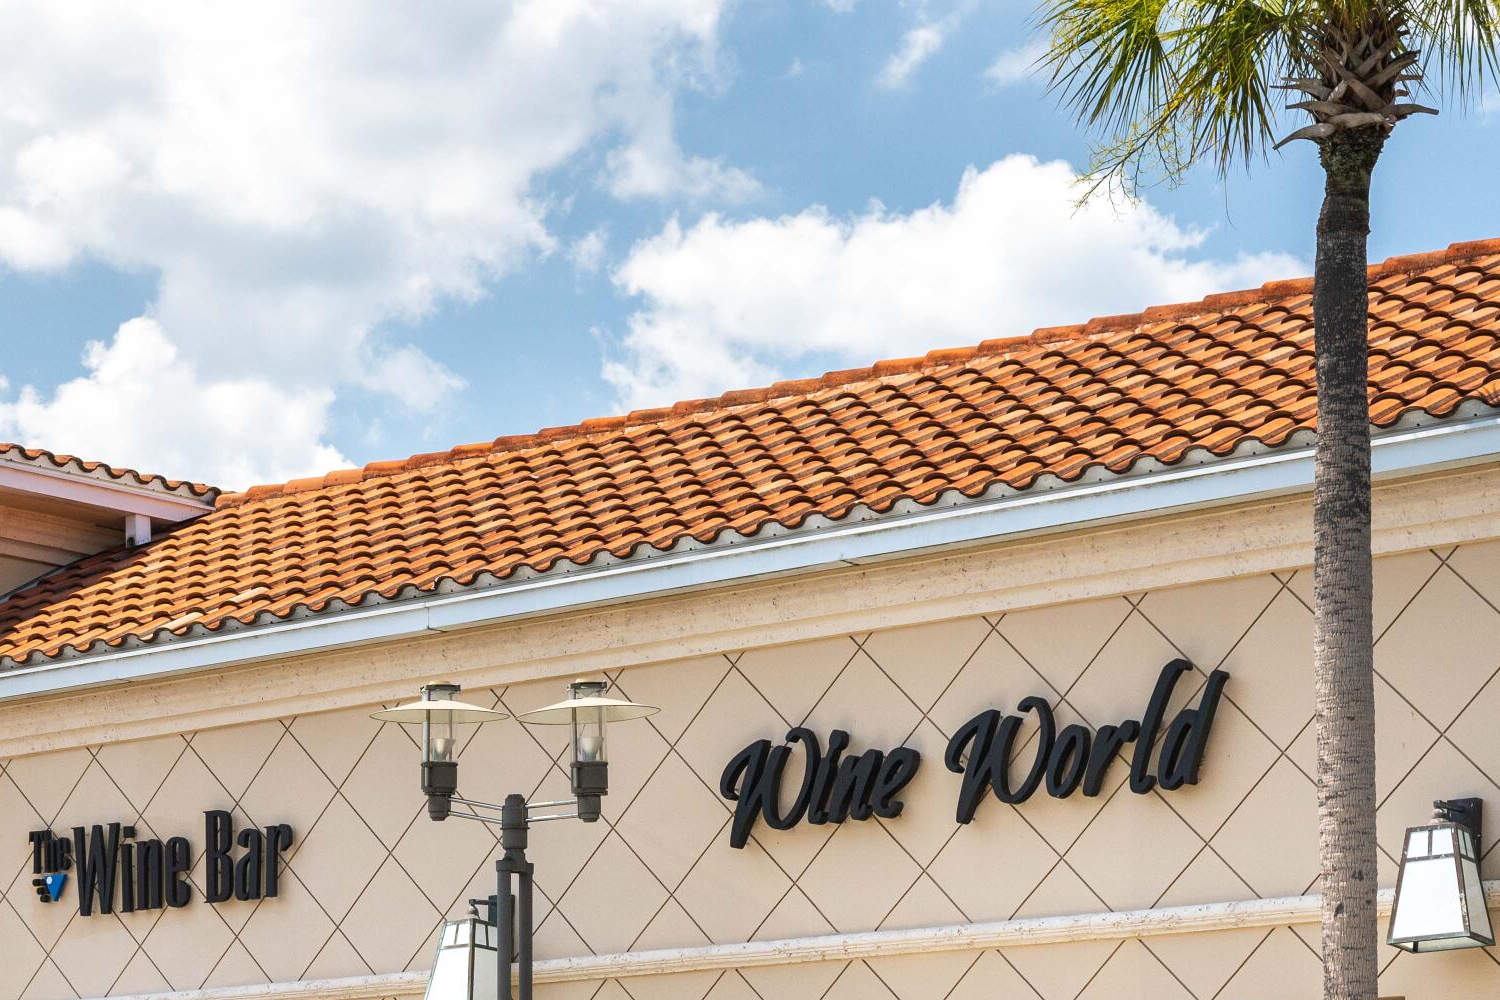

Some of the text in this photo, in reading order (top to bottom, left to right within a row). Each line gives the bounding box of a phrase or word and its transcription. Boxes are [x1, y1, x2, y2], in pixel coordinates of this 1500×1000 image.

[719, 658, 1230, 849] Wine World
[29, 809, 294, 917] The Wine Bar
